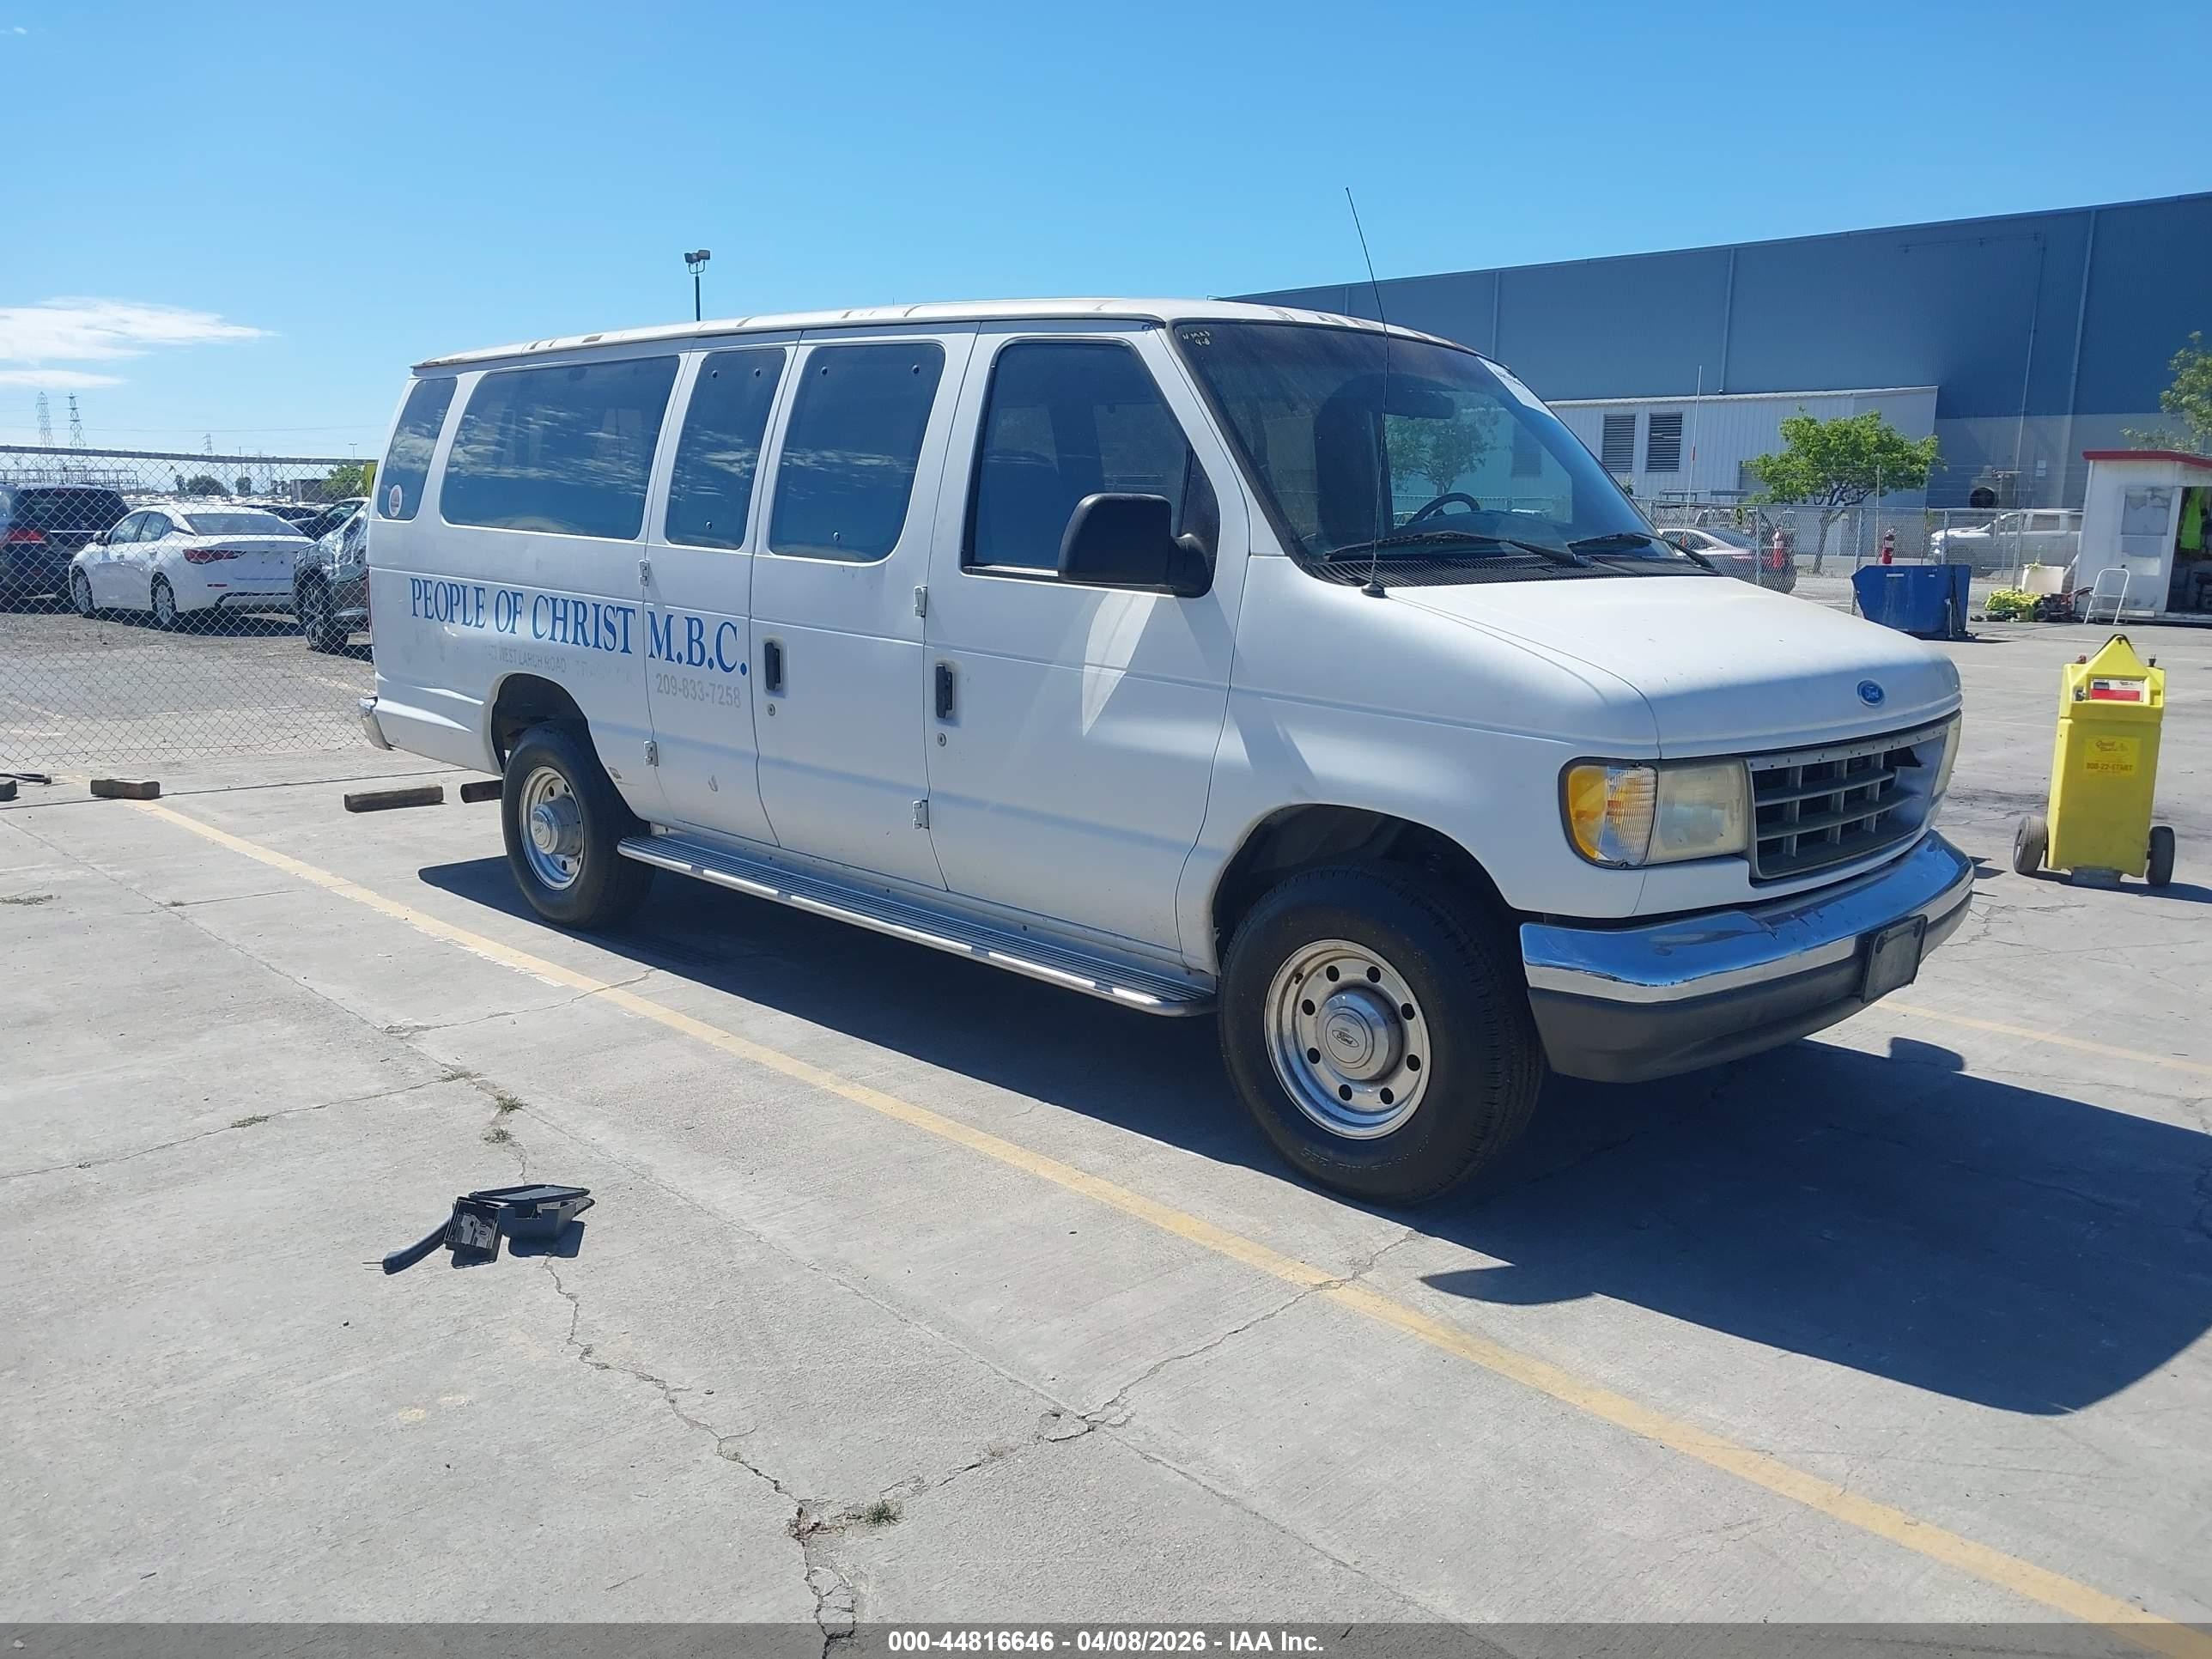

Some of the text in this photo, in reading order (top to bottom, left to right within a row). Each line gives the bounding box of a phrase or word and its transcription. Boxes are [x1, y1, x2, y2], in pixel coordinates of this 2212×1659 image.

[1736, 508, 1742, 525] 9
[410, 578, 486, 629] PEOPLE
[495, 590, 524, 635] OF
[532, 595, 635, 654] CHRIST
[647, 611, 747, 676] M.B.C.
[655, 673, 742, 708] 209-833-7258
